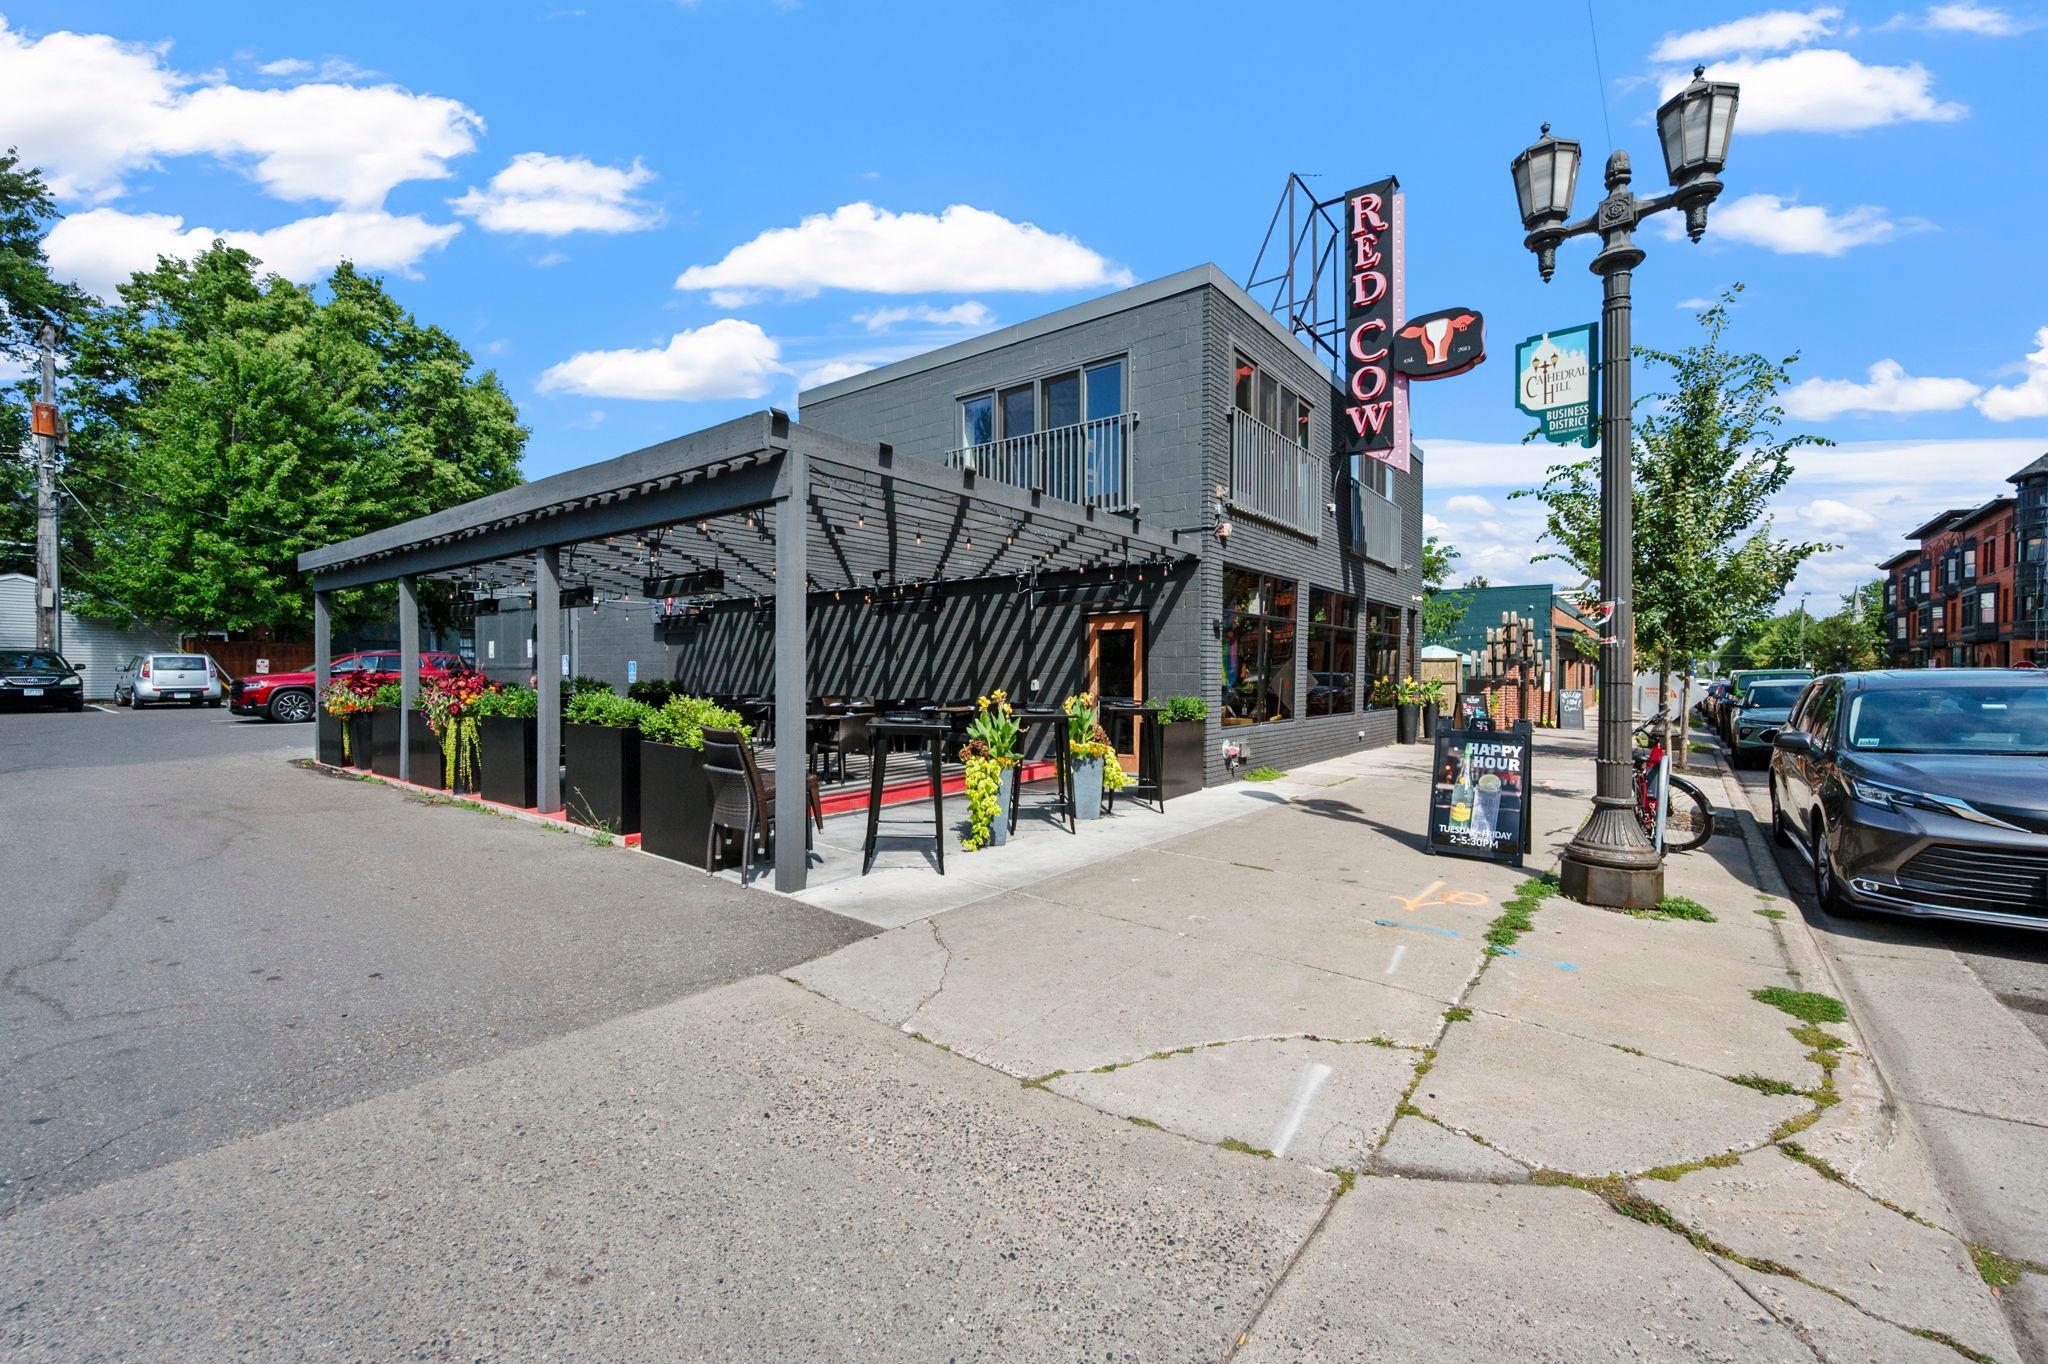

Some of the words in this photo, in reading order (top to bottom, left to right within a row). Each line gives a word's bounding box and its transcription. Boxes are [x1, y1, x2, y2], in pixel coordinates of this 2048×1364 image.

[1351, 192, 1389, 306] RED
[1346, 318, 1392, 437] COW
[1546, 404, 1589, 421] BUSINESS
[1549, 415, 1589, 431] DISTRICT
[1468, 742, 1523, 759] HAPPY
[1473, 755, 1520, 772] HOUR
[1438, 824, 1477, 837] TUESDAY
[1482, 829, 1512, 841] FRIDAY
[1450, 834, 1499, 849] 2-5:30PM
